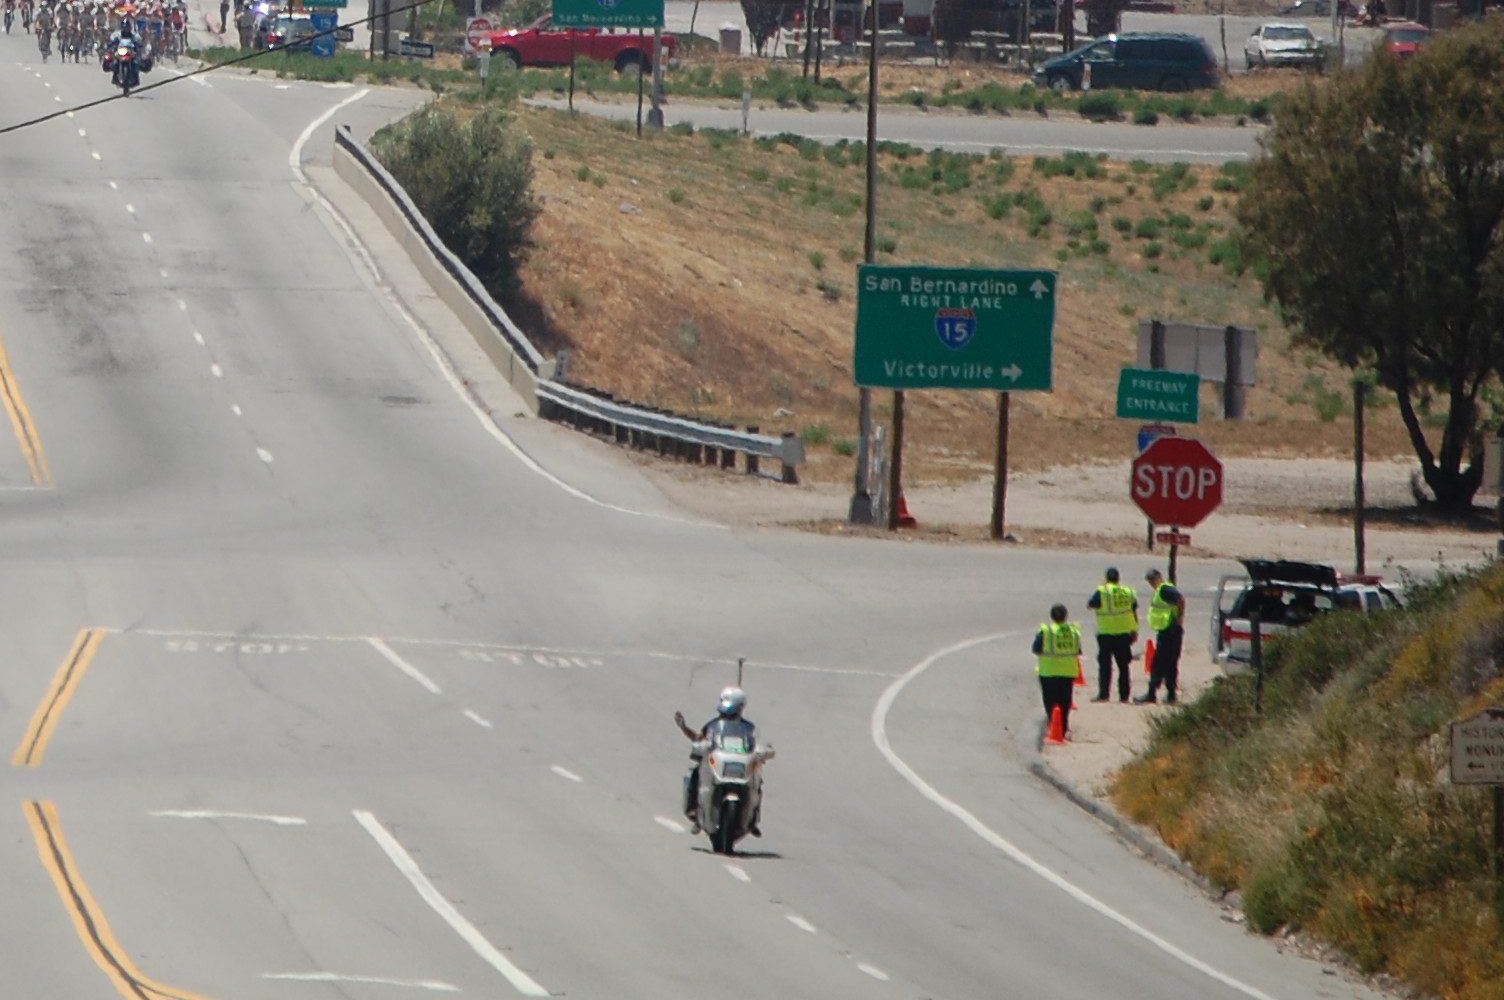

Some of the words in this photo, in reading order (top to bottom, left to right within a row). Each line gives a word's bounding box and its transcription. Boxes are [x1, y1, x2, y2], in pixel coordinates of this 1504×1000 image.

[320, 18, 332, 28] 15
[865, 275, 902, 292] San
[910, 277, 1018, 295] Bernardino
[900, 295, 951, 308] RIGHT
[961, 296, 1003, 309] LANE
[944, 322, 968, 342] 15
[884, 360, 993, 380] Victorville
[1131, 378, 1188, 394] FREEWAY
[1126, 397, 1190, 414] ENTRANCE
[1136, 463, 1216, 501] STOP
